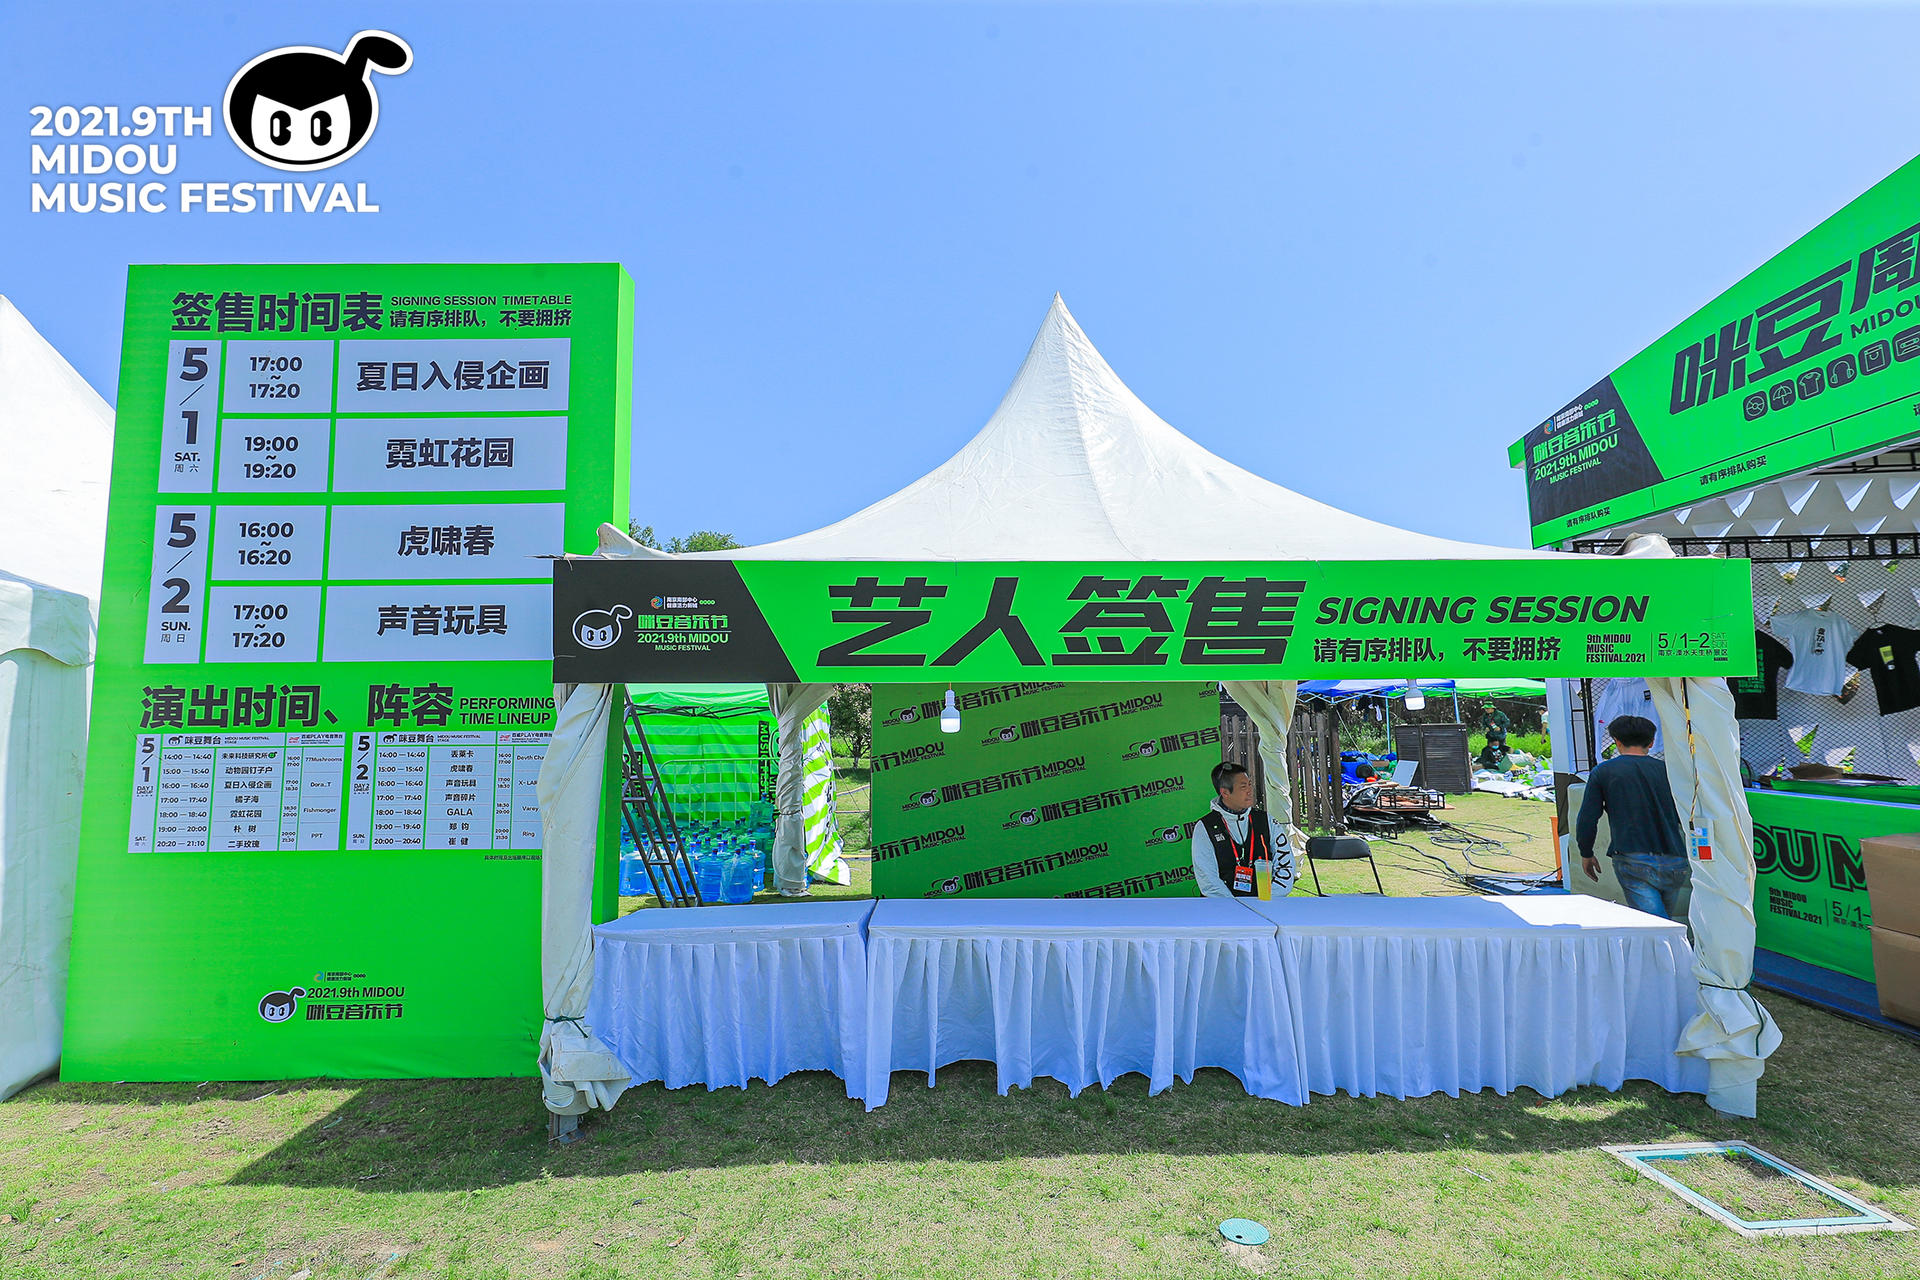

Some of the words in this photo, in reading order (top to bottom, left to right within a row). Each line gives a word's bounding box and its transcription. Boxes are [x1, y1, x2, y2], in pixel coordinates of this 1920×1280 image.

[391, 296, 441, 306] SIGNING
[443, 295, 496, 306] SESSION
[502, 295, 572, 306] TIMETABLE
[171, 291, 383, 333] 签售时间表
[1851, 294, 1920, 339] MIDO
[250, 356, 302, 371] 17:00
[356, 360, 549, 391] 夏日入侵企画
[249, 383, 300, 398] 17:20
[244, 437, 298, 451] 19:00
[1533, 408, 1616, 464] 咪豆音乐节
[174, 452, 200, 462] SAT.
[386, 437, 514, 468] 霓虹花园
[1535, 452, 1577, 481] 2021.9th
[1578, 433, 1618, 461] MIDOU
[244, 463, 296, 478] 19:20
[1549, 470, 1569, 484] MUSIC
[1569, 458, 1602, 476] FESTIVAL
[1699, 455, 1766, 485] 请有序排队购买
[239, 522, 294, 538] 16:00
[397, 524, 495, 557] 虎啸春
[238, 550, 291, 565] 16:20
[233, 604, 288, 620] 17:00
[1315, 596, 1476, 625] SIGNING
[1485, 595, 1649, 623] SESSION
[161, 621, 191, 631] SUN.
[376, 604, 508, 636] 声音玩具
[637, 614, 729, 630] 咪豆音乐节
[816, 575, 1307, 667] 艺人签售
[232, 632, 285, 648] 17:20
[637, 633, 687, 643] 2021.9th
[688, 633, 729, 643] MIDOU
[1587, 633, 1601, 643] 9th
[1603, 633, 1631, 643] MIDOU
[1586, 643, 1614, 653] MUSIC
[1586, 653, 1646, 663] FESTIVAL.2021
[139, 683, 454, 729] 演出时间、阵容
[459, 697, 555, 710] PERFORMING
[1119, 692, 1162, 712] MIDOU
[459, 712, 494, 725] TIME
[497, 711, 551, 725] LINEUP
[1020, 703, 1121, 739] 咪豆音乐节
[1160, 726, 1221, 753] 咪豆音
[900, 741, 944, 761] MIDOU
[1041, 756, 1085, 774] MIDOU
[224, 781, 272, 789] 夏日入侵企画
[941, 766, 1042, 803] 咪豆音乐节
[1140, 775, 1184, 793] MIDOU
[446, 808, 473, 816] GALA
[1041, 785, 1141, 822] 咪豆音乐节
[921, 825, 965, 844] MIDOU
[1064, 841, 1108, 861] MIDOU
[1271, 833, 1293, 889] TOKYO
[963, 851, 1065, 890] 咪豆音乐节
[307, 986, 360, 998] 2021.9th
[363, 986, 405, 997] MIDOU
[306, 1003, 403, 1020] 咪豆音乐节
